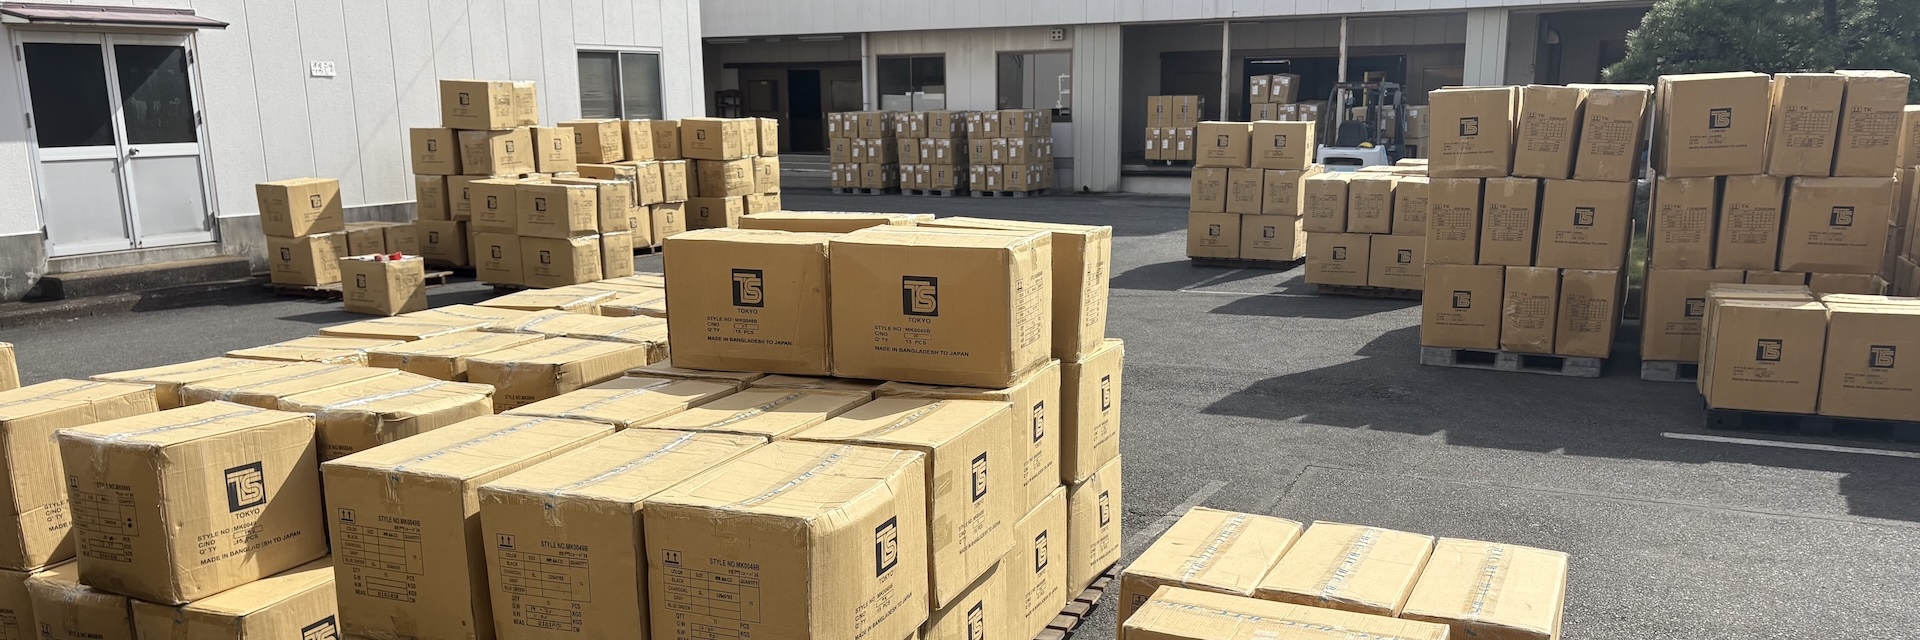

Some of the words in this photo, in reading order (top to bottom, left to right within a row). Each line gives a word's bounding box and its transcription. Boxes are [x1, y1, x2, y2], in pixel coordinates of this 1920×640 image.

[1460, 117, 1478, 136] TS
[1709, 108, 1731, 129] TS
[1574, 207, 1595, 226] TS
[1830, 206, 1854, 226] TS
[732, 268, 764, 307] TS
[903, 276, 938, 317] TS
[1453, 291, 1471, 308] TS
[1756, 339, 1782, 361] TS
[1868, 345, 1896, 368] TS
[224, 460, 266, 513] TS
[972, 451, 987, 502] TS
[235, 508, 260, 519] TOKYO
[49, 522, 68, 531] MADE
[198, 531, 218, 541] STYLE
[198, 540, 216, 548] C/NO
[201, 556, 220, 565] MADE
[283, 530, 301, 540] JAPAN
[876, 515, 898, 578] TS
[710, 558, 726, 567] STYLE
[879, 570, 894, 584] TOKYO
[872, 606, 897, 628] BANGLADESH
